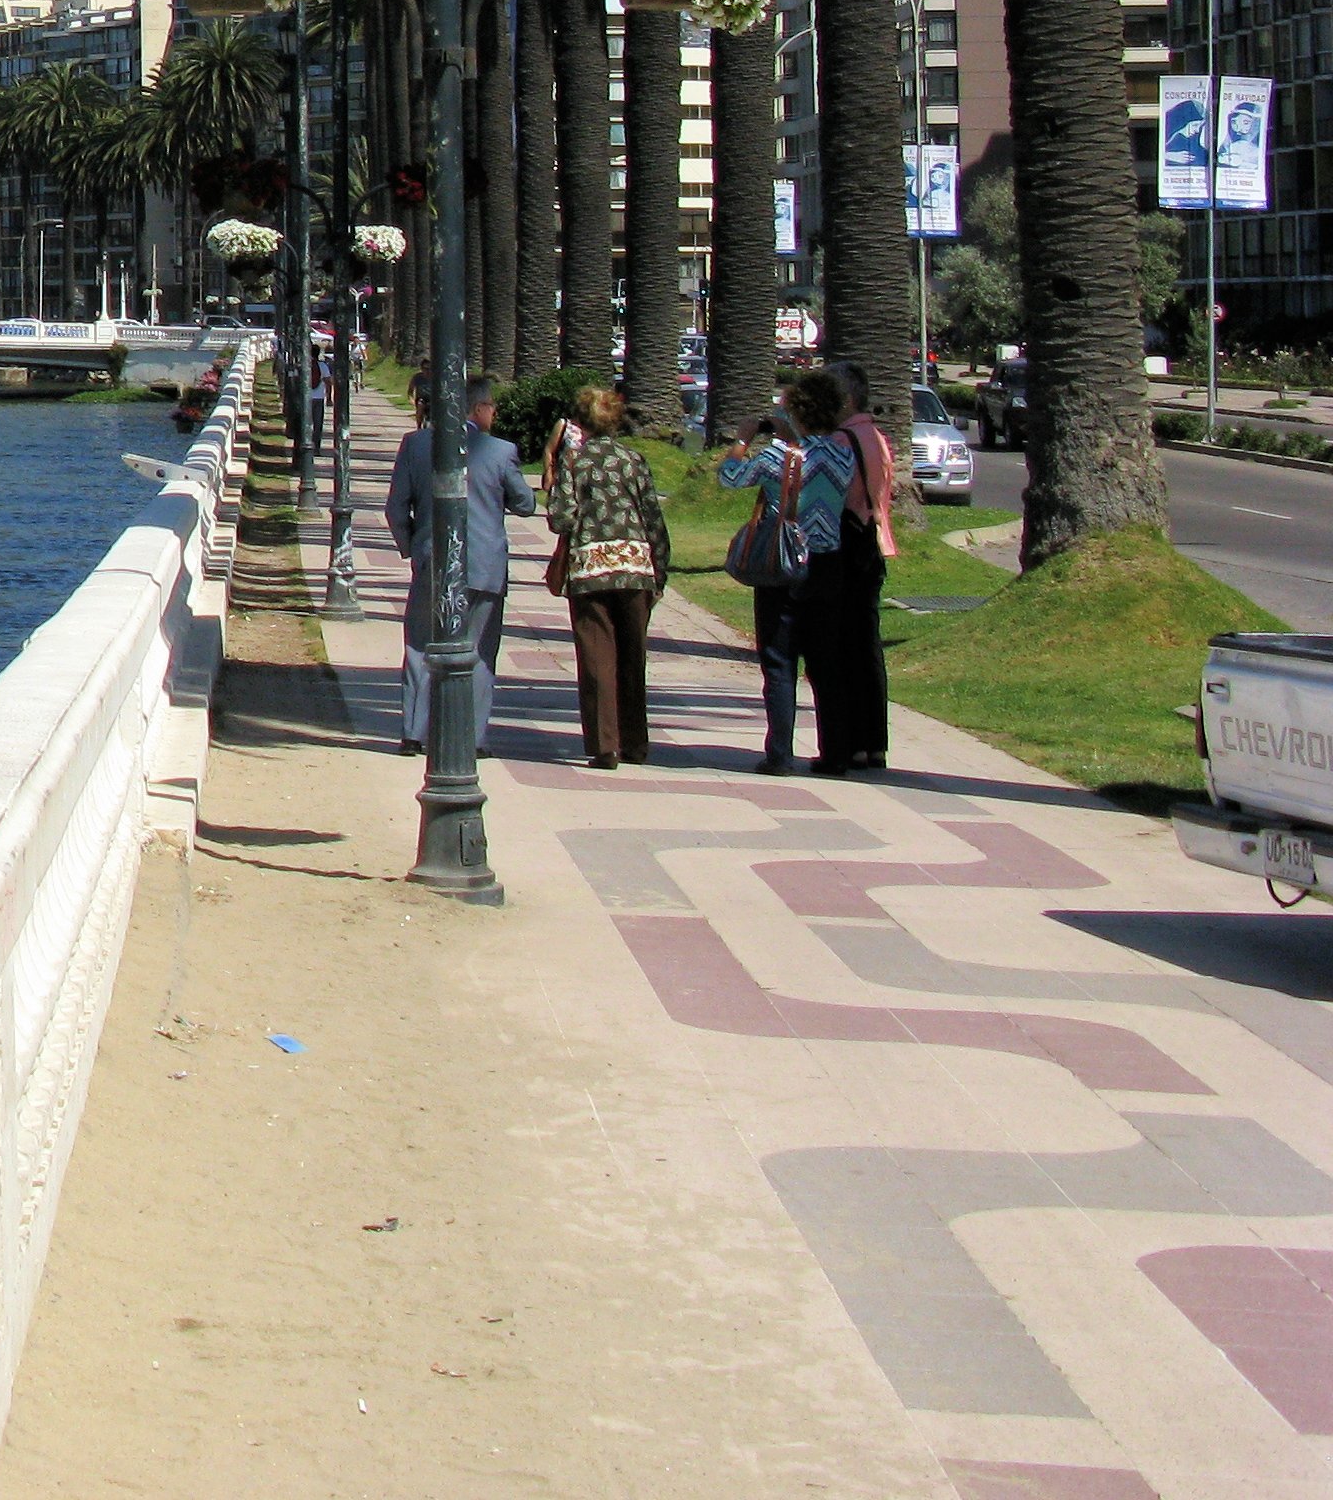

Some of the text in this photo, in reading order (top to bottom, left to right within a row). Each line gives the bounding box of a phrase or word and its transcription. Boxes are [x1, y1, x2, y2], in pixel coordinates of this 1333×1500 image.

[1164, 91, 1207, 100] CONCIERTO
[1223, 92, 1266, 103] DE NAVIDAD
